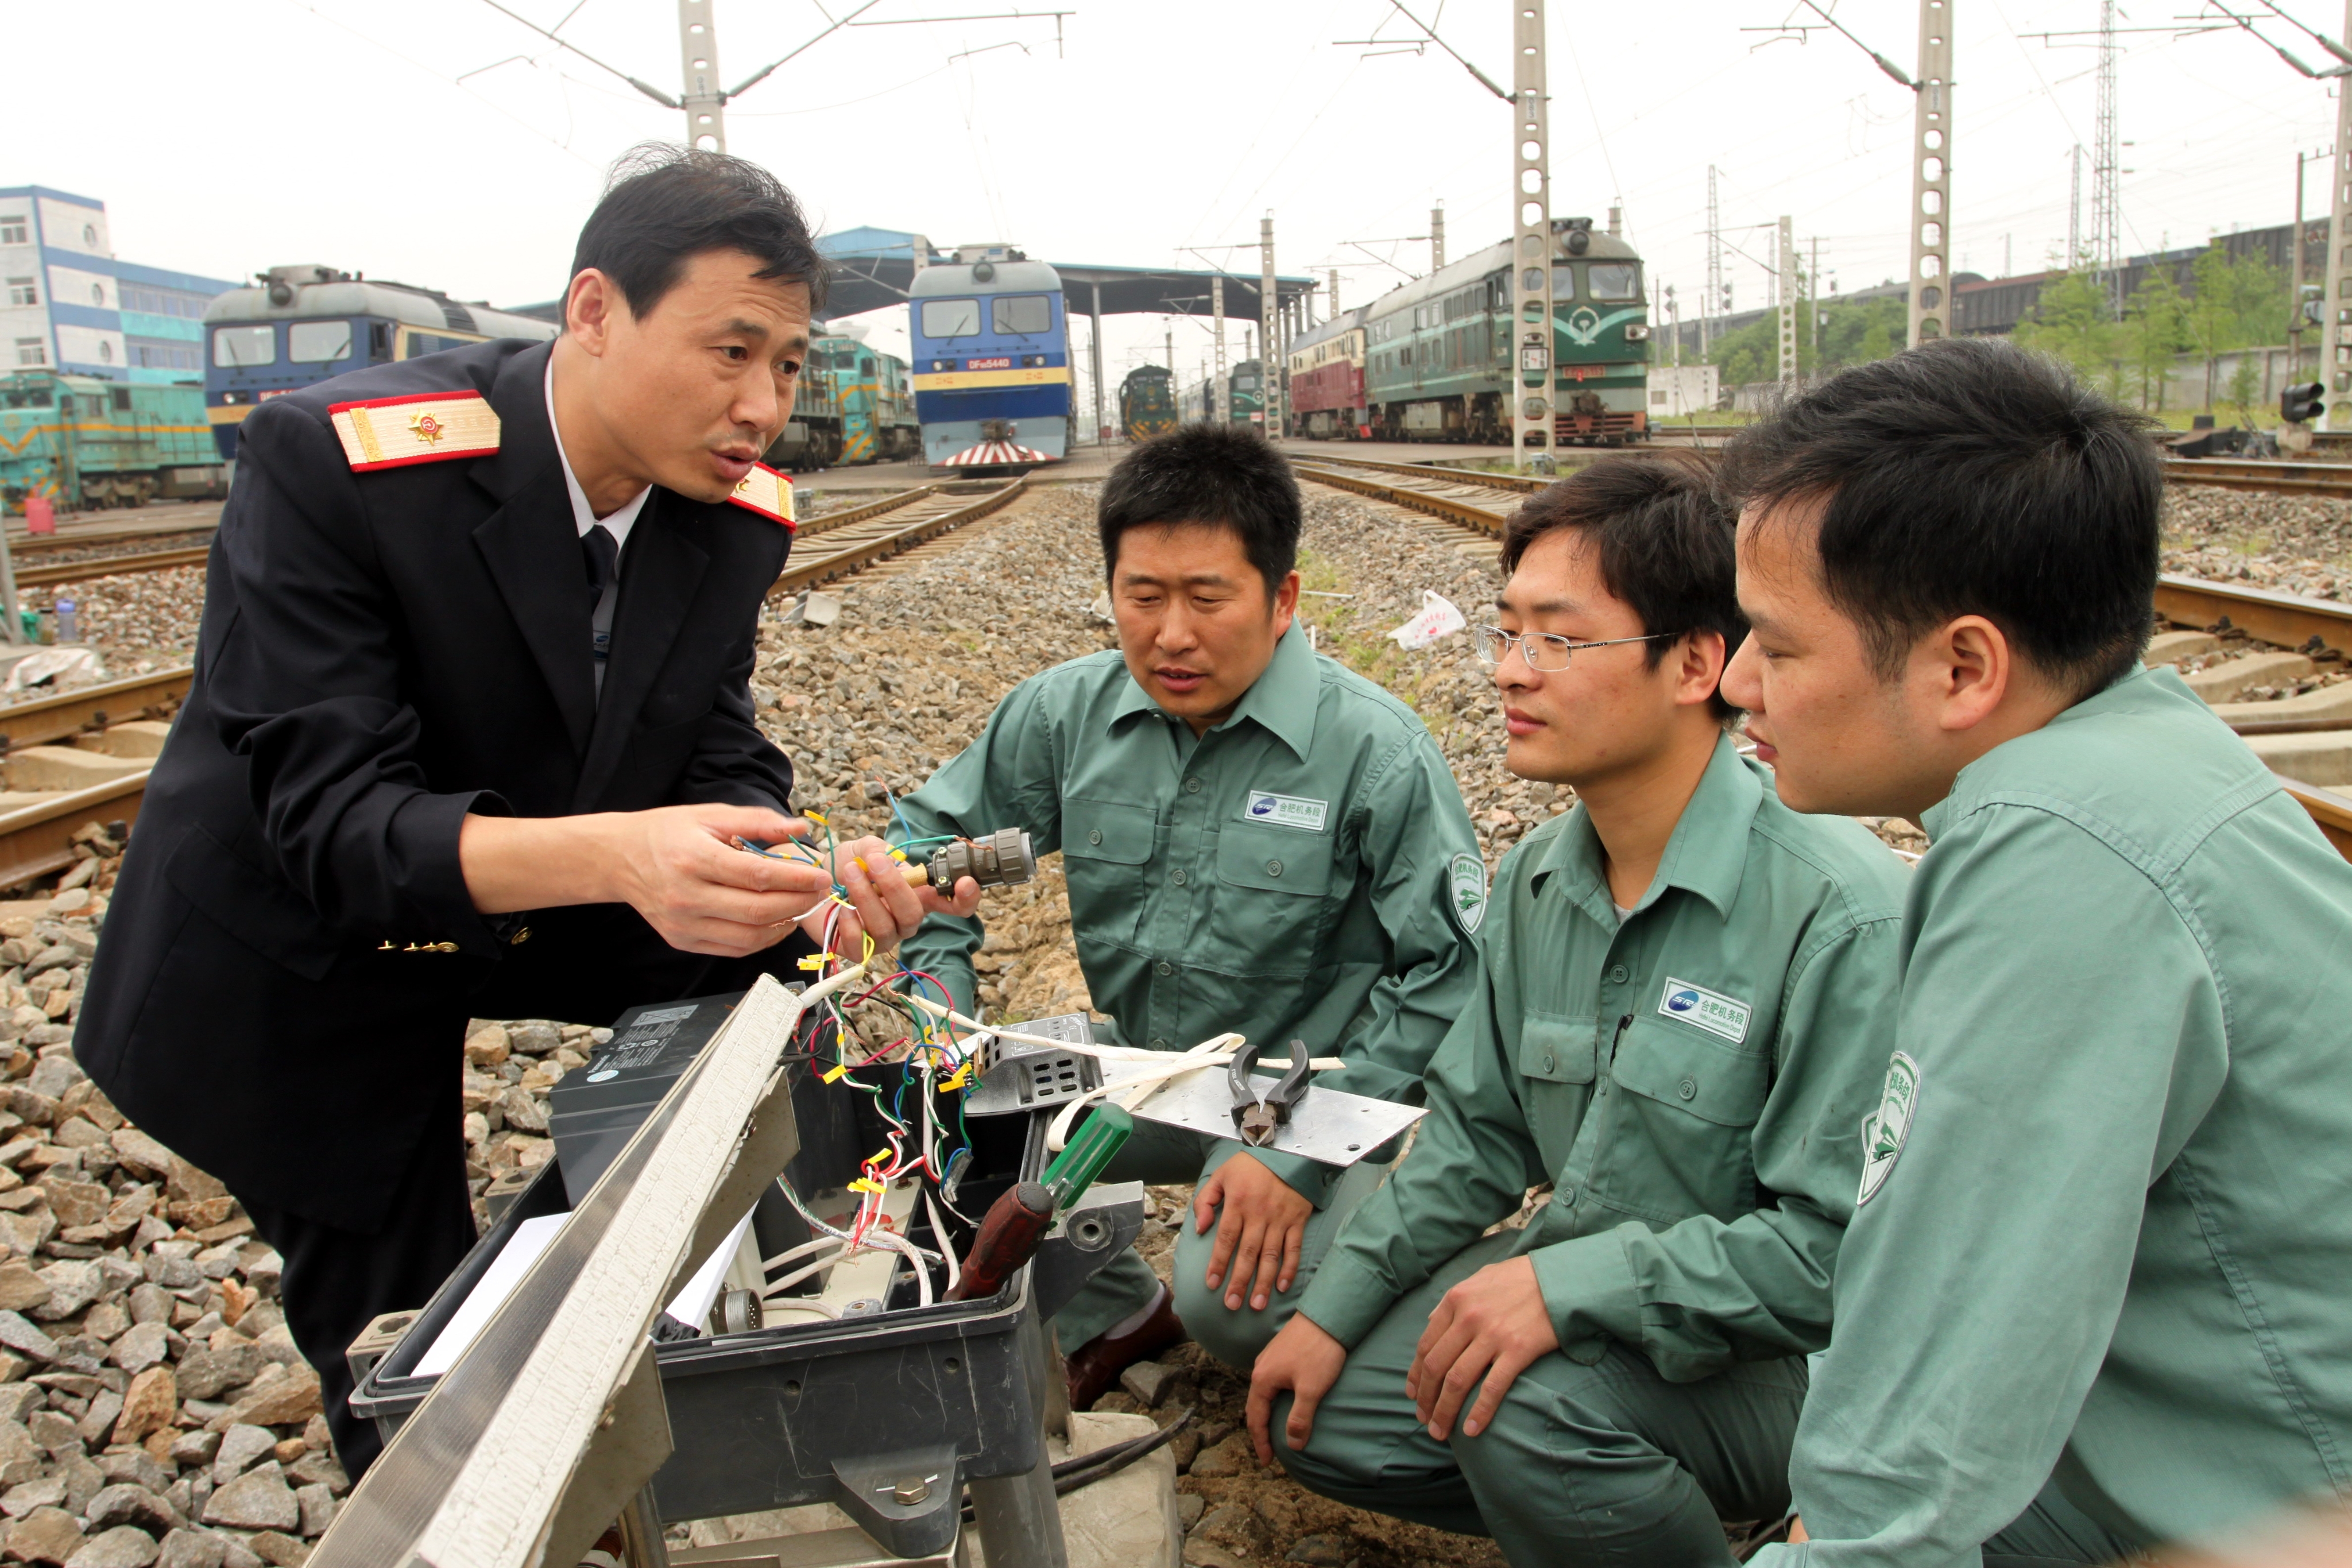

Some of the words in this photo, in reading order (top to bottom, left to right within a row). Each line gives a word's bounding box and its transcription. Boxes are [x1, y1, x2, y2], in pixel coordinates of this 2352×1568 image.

[1279, 802, 1321, 817] 合肥机务段
[1699, 1012, 1708, 1021] Hefei
[1708, 1015, 1730, 1029] Locomotive
[1730, 1024, 1741, 1034] Depot
[1701, 1000, 1744, 1025] 合肥机务段
